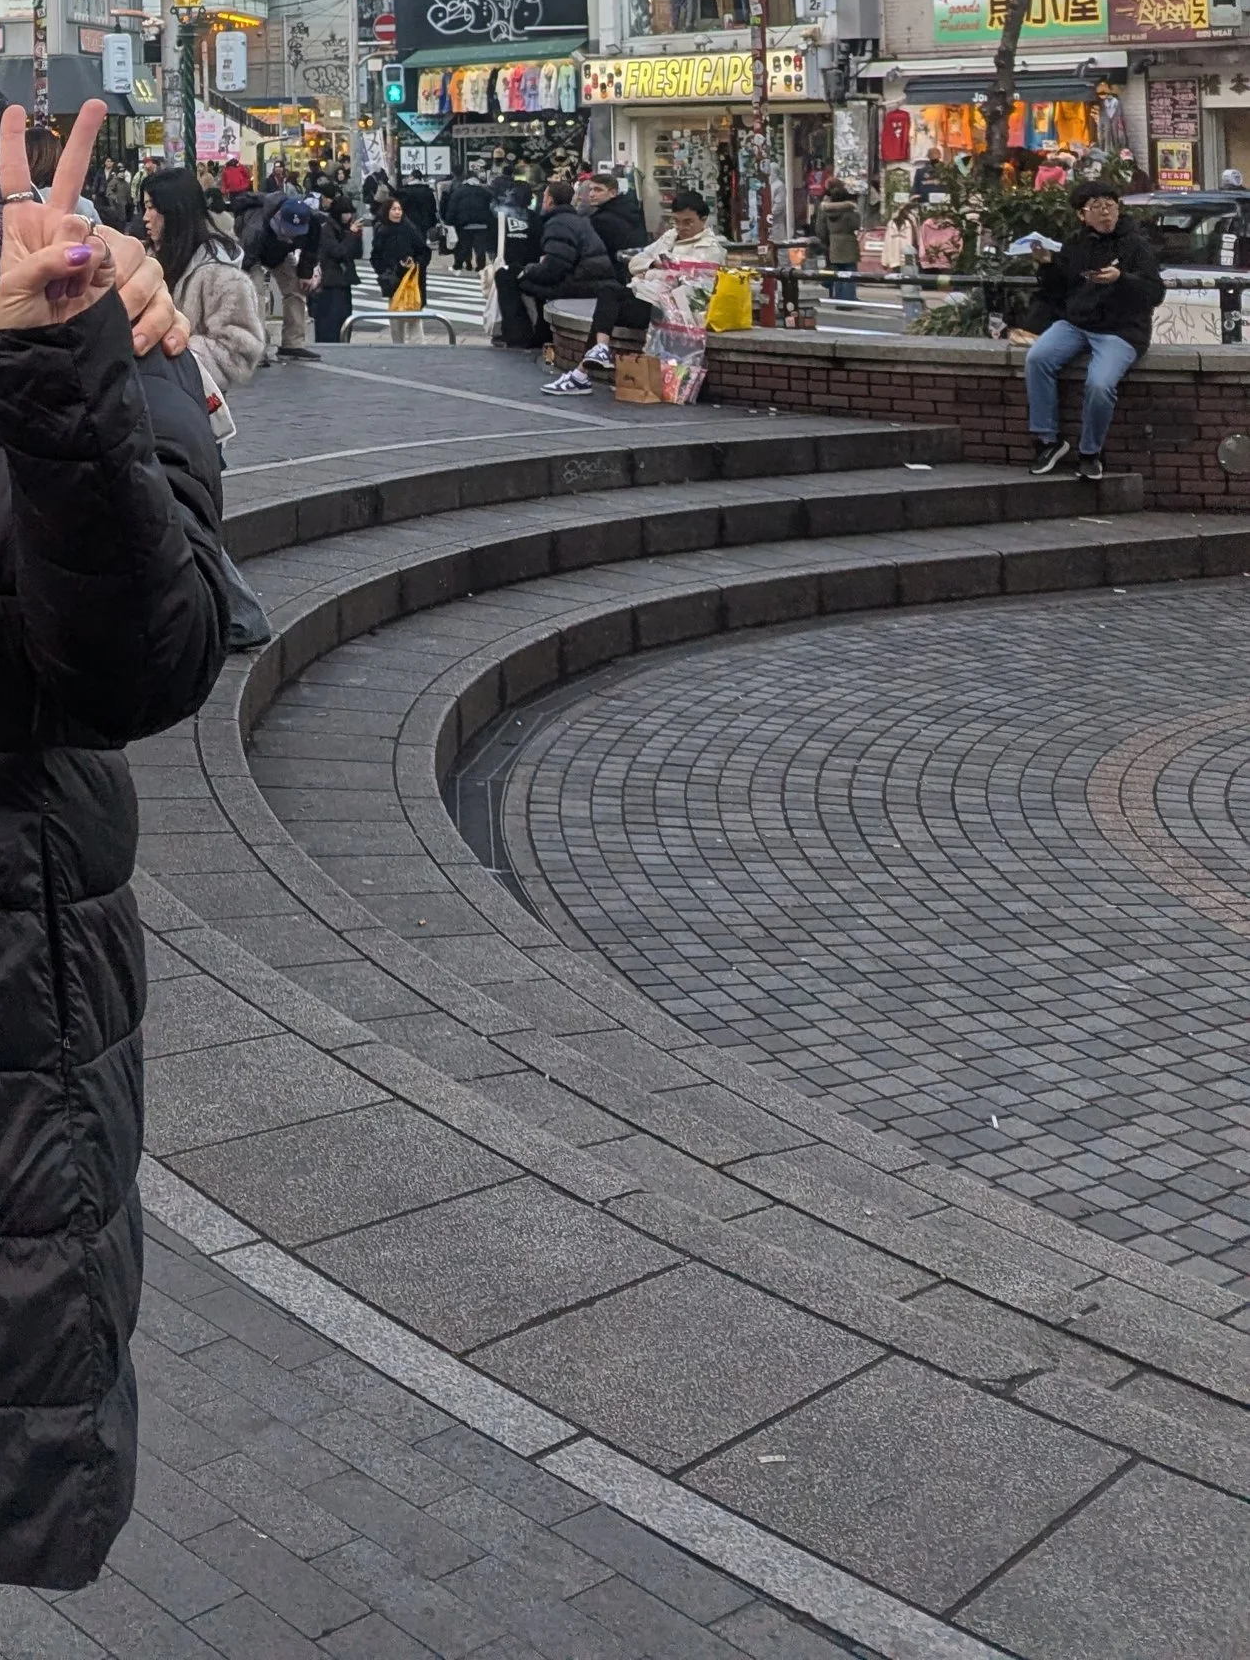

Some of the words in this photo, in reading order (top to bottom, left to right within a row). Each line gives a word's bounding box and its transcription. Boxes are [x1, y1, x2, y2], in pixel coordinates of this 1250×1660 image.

[809, 0, 821, 11] 2F
[948, 0, 980, 20] goods
[623, 58, 694, 98] FRESH
[695, 55, 754, 97] CAPS
